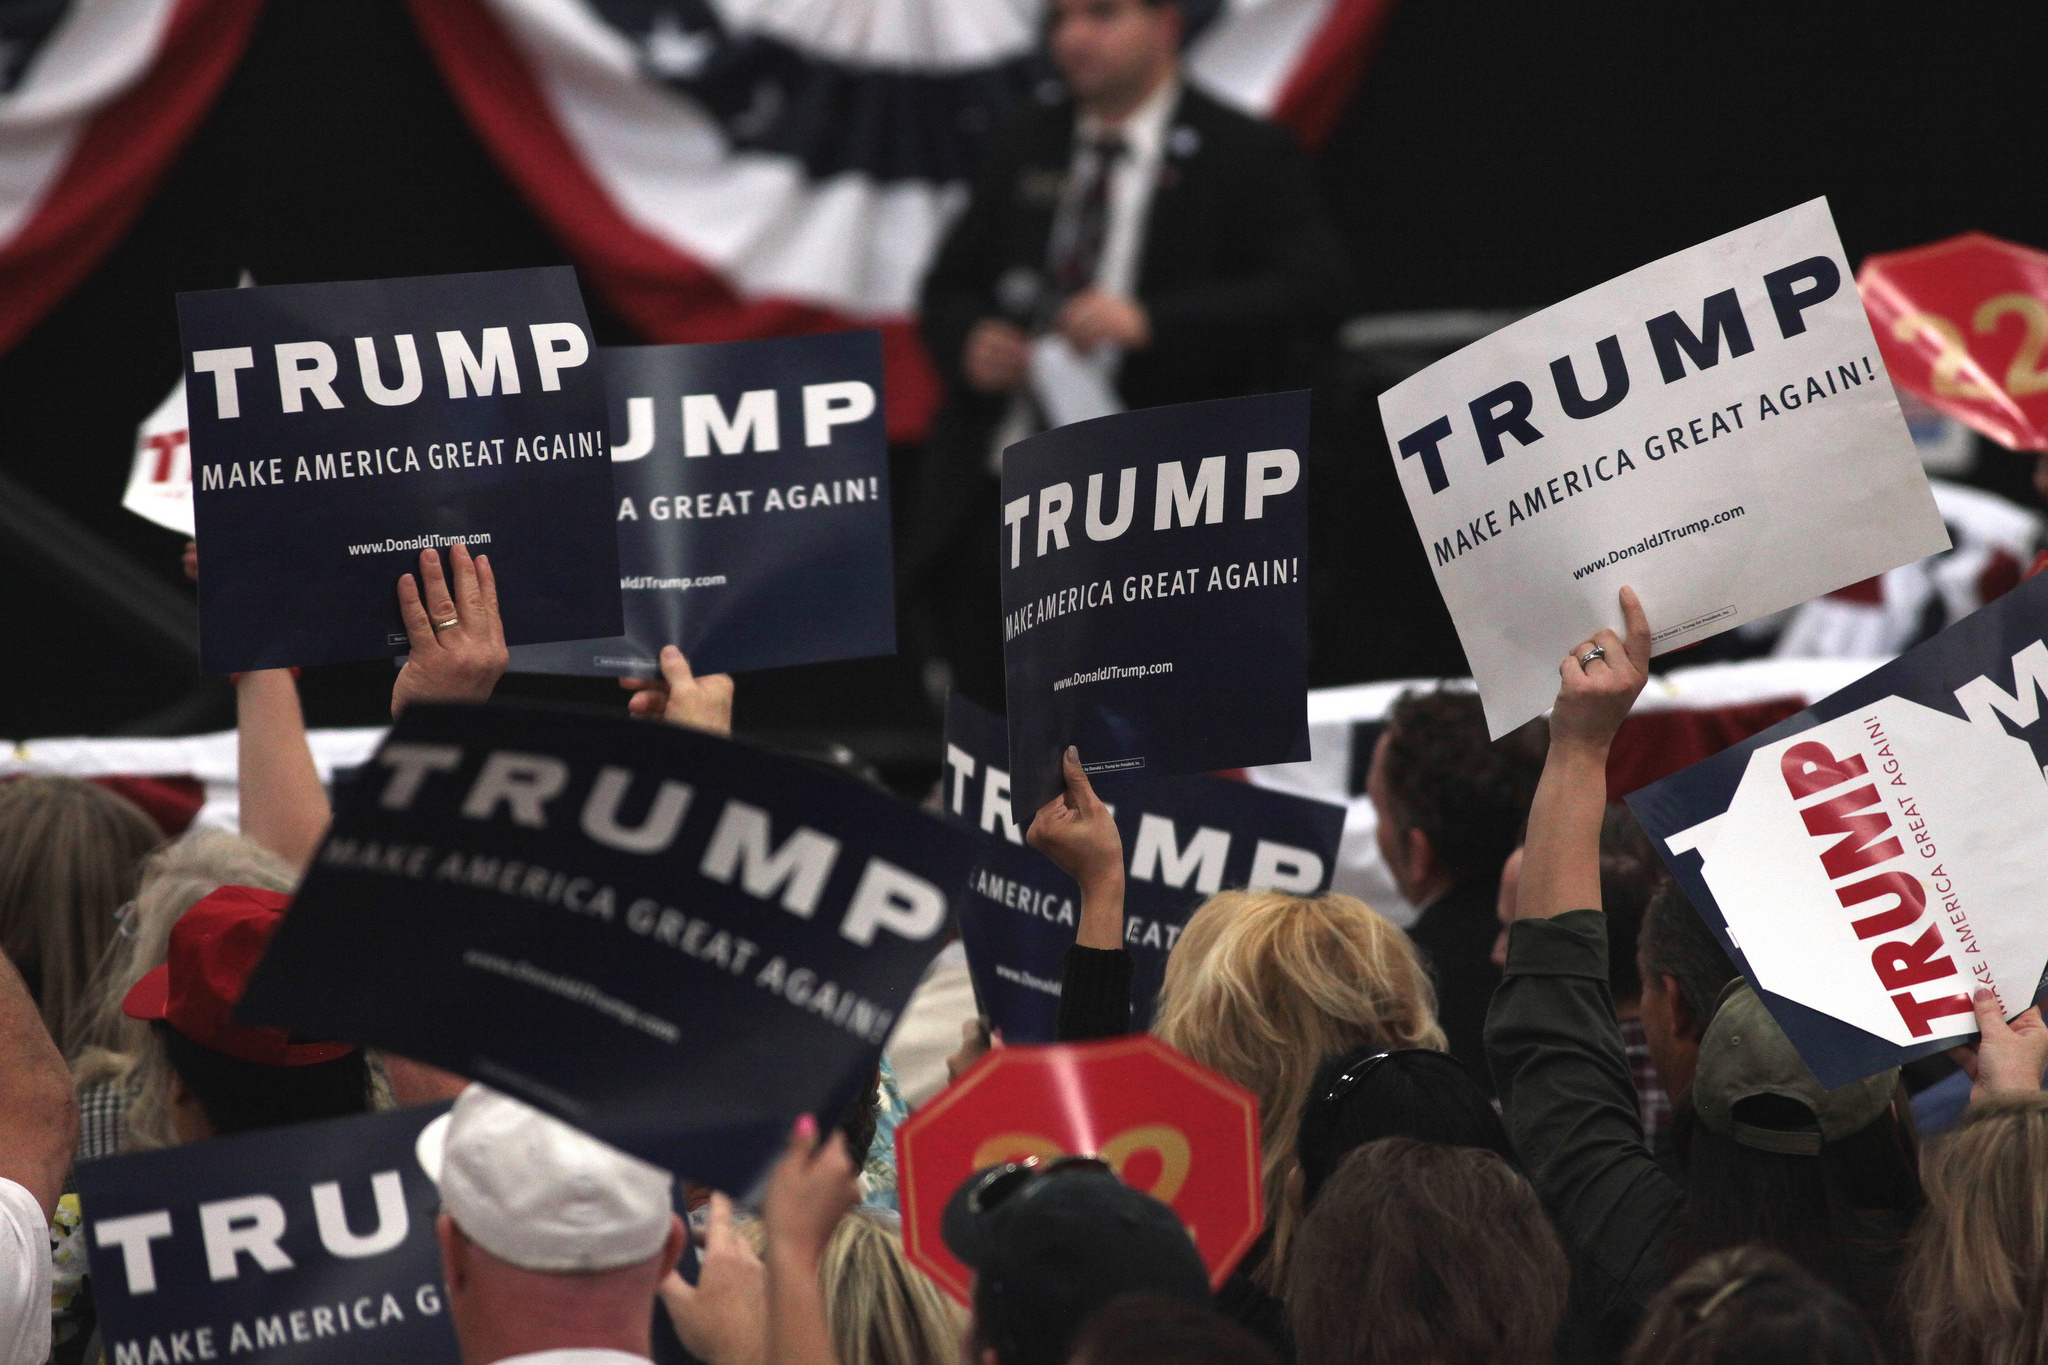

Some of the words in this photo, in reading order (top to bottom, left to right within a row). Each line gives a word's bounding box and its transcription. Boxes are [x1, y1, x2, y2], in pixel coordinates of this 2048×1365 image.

[193, 323, 588, 418] TRUMP
[1398, 256, 1840, 494] TRUMP
[203, 459, 283, 490] MAKE
[295, 447, 420, 482] AMERICA
[429, 439, 504, 469] GREAT
[516, 431, 602, 462] AGAIN!
[611, 380, 877, 463] UMP
[1434, 511, 1501, 566] MAKE
[1509, 449, 1635, 526] AMERICA
[1645, 403, 1743, 460] GREAT
[1761, 357, 1874, 420] AGAIN!
[650, 491, 752, 520] GREAT
[765, 478, 877, 511] AGAIN!
[1005, 449, 1300, 569] TRUMP
[349, 534, 491, 555] www.DonaldJTrump.com
[1573, 506, 1745, 580] www.DonaldJTrump.com
[1006, 603, 1033, 641] MAKE
[1037, 581, 1113, 624] AMERICA
[1123, 569, 1199, 601] GREAT
[1208, 558, 1297, 591] AGAIN!
[1054, 663, 1172, 691] www.DonaldJTrump.com
[1863, 715, 1907, 787] AGAIN!
[374, 736, 948, 948] TRUMP
[948, 744, 1322, 896] TRMP
[1896, 796, 1937, 859] GREAT
[976, 869, 1073, 926] AMERICA
[1126, 916, 1188, 955] EAT
[1781, 740, 1975, 1039] TRUMP
[1930, 863, 1981, 954] AMERICA
[437, 853, 615, 919] AMERICA
[627, 900, 757, 973] GREAT
[757, 957, 892, 1042] AGAIN!
[94, 1169, 411, 1296] TRU
[116, 1329, 214, 1365] MAKE
[232, 1294, 403, 1350] AMERICA
